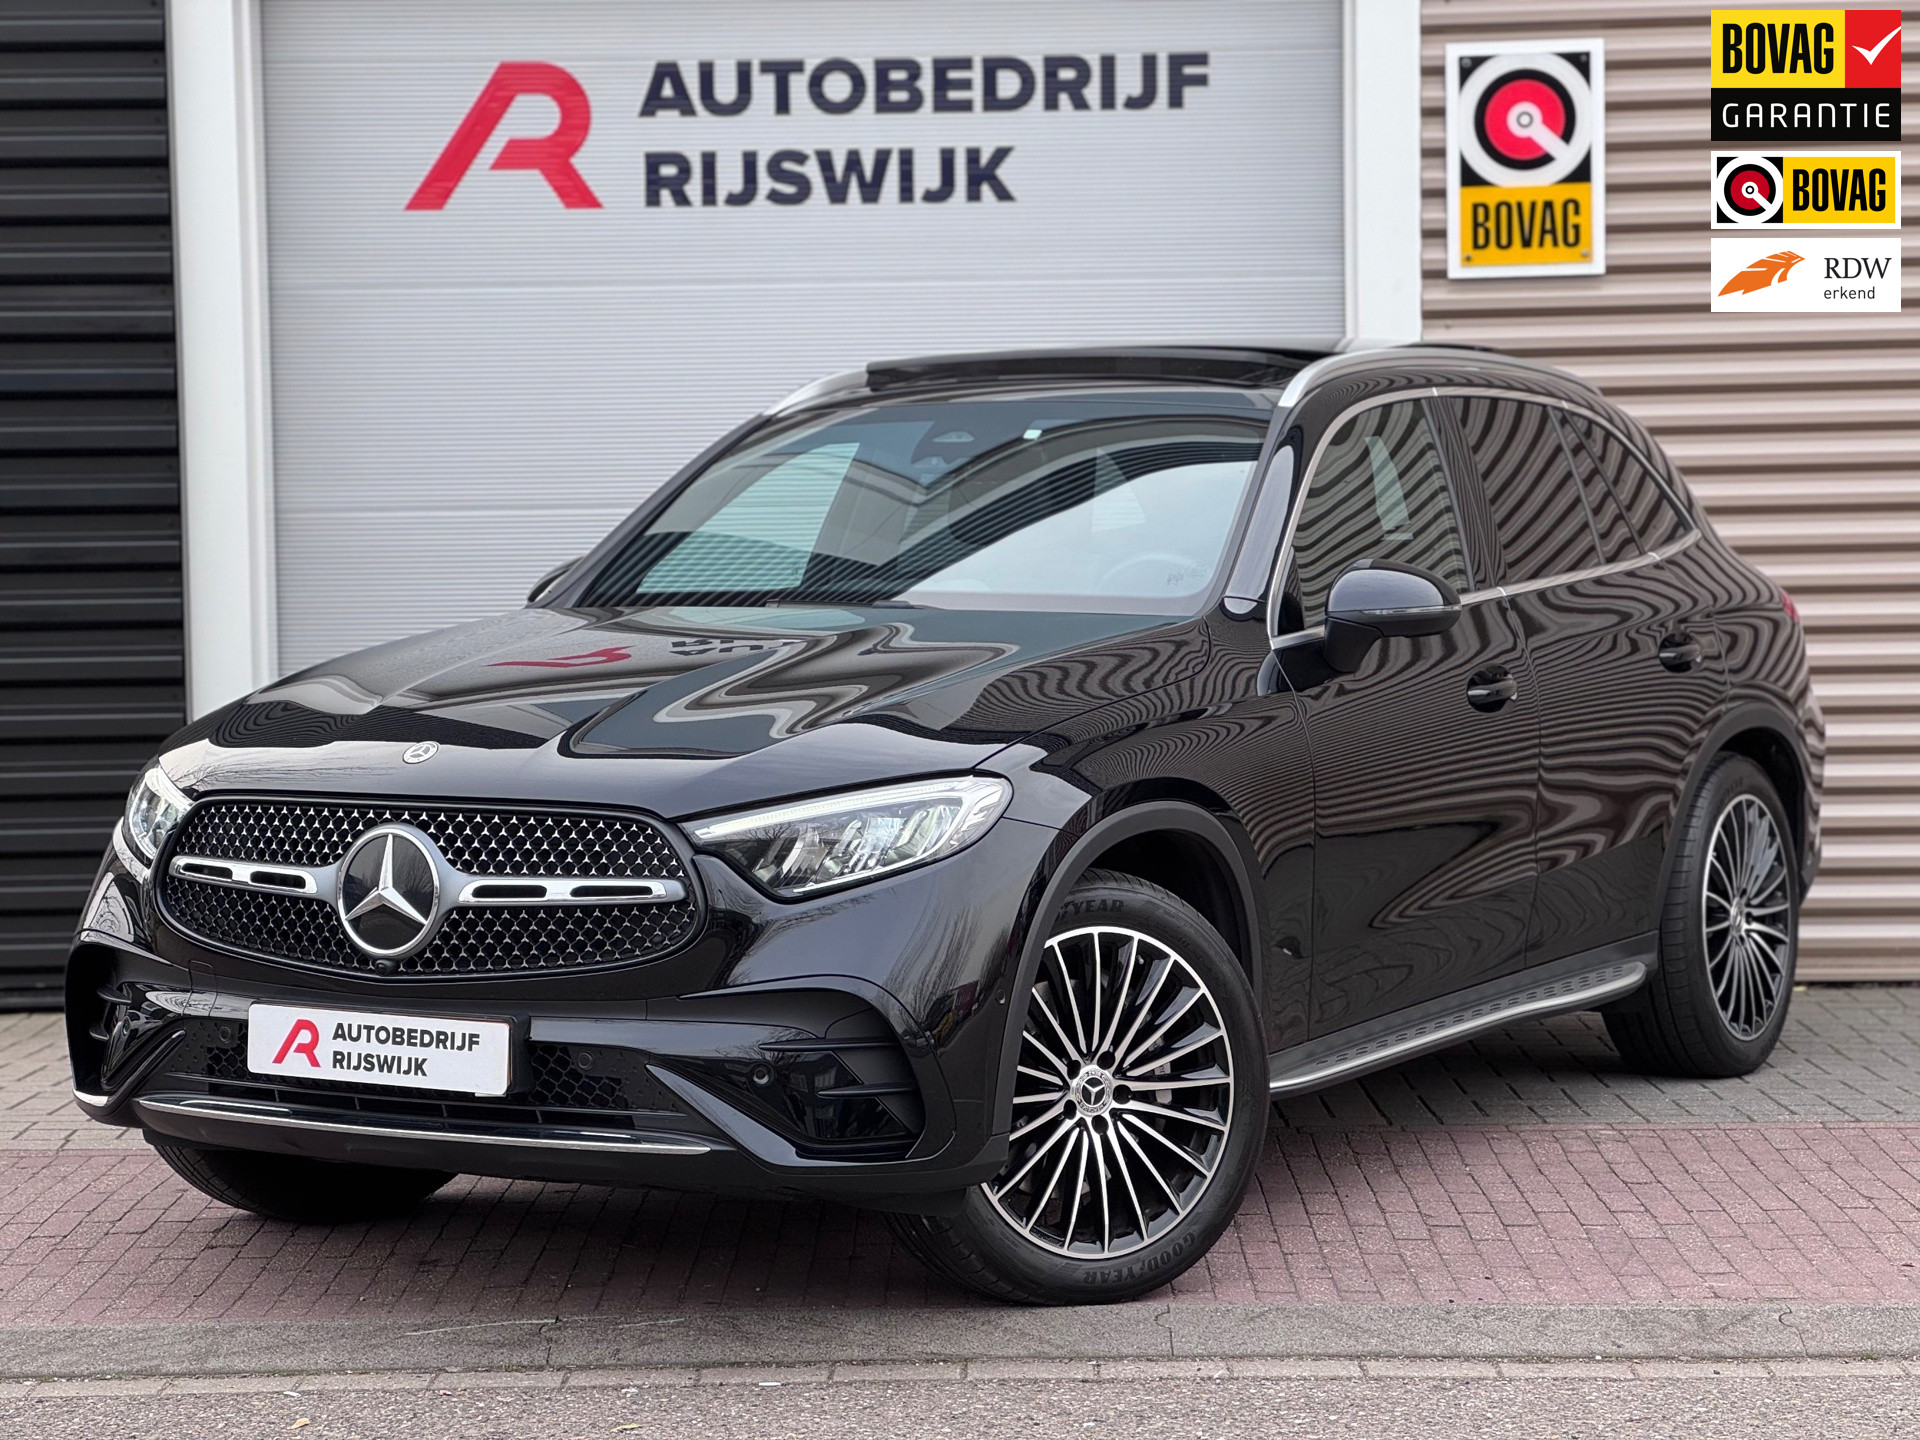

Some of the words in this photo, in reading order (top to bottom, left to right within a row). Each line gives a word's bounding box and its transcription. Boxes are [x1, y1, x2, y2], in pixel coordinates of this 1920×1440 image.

[639, 52, 1210, 117] AUTOBEDRIJF
[644, 146, 1016, 208] RIJSWIJK
[1472, 198, 1581, 250] BOVAG
[332, 1022, 480, 1052] AUTOBEDRIJF
[332, 1050, 428, 1077] RIJSWIJK
